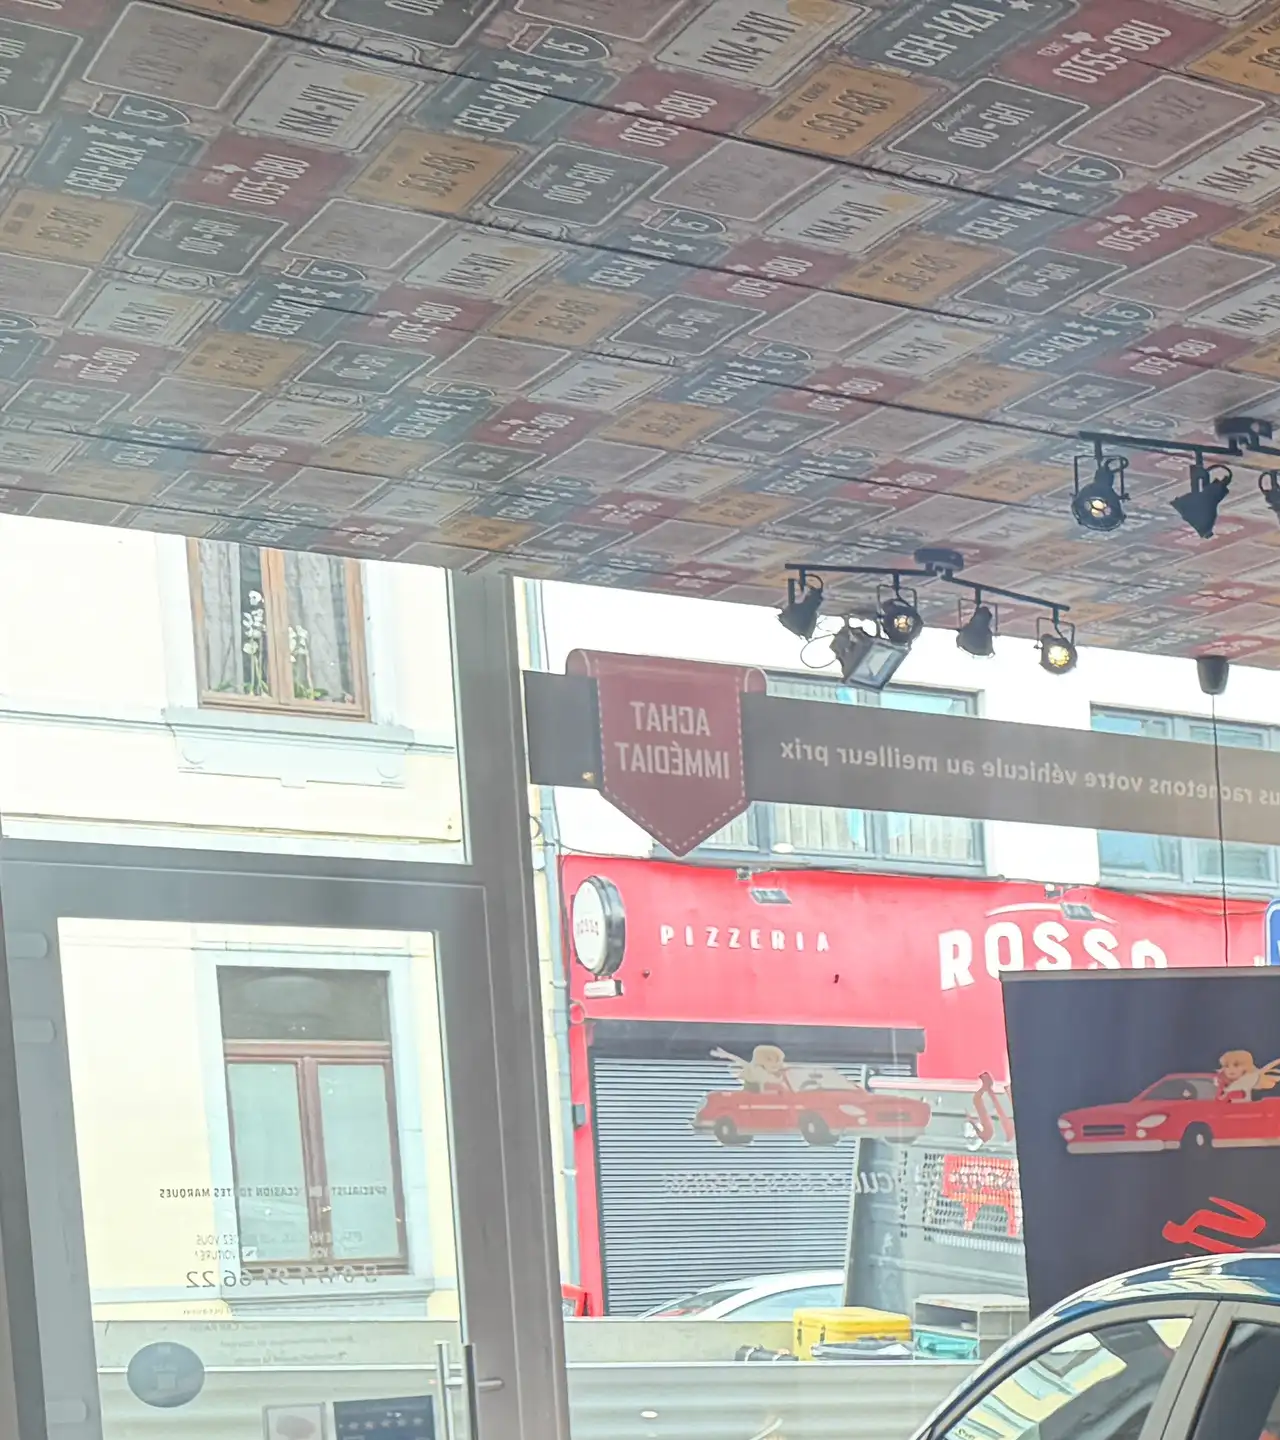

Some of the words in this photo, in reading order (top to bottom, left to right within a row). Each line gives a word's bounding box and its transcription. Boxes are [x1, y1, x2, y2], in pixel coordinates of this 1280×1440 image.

[542, 36, 595, 58] 15
[883, 1, 1007, 69] GEH-142A
[63, 140, 152, 194] GEH-142A
[659, 924, 830, 951] PIZZERIA
